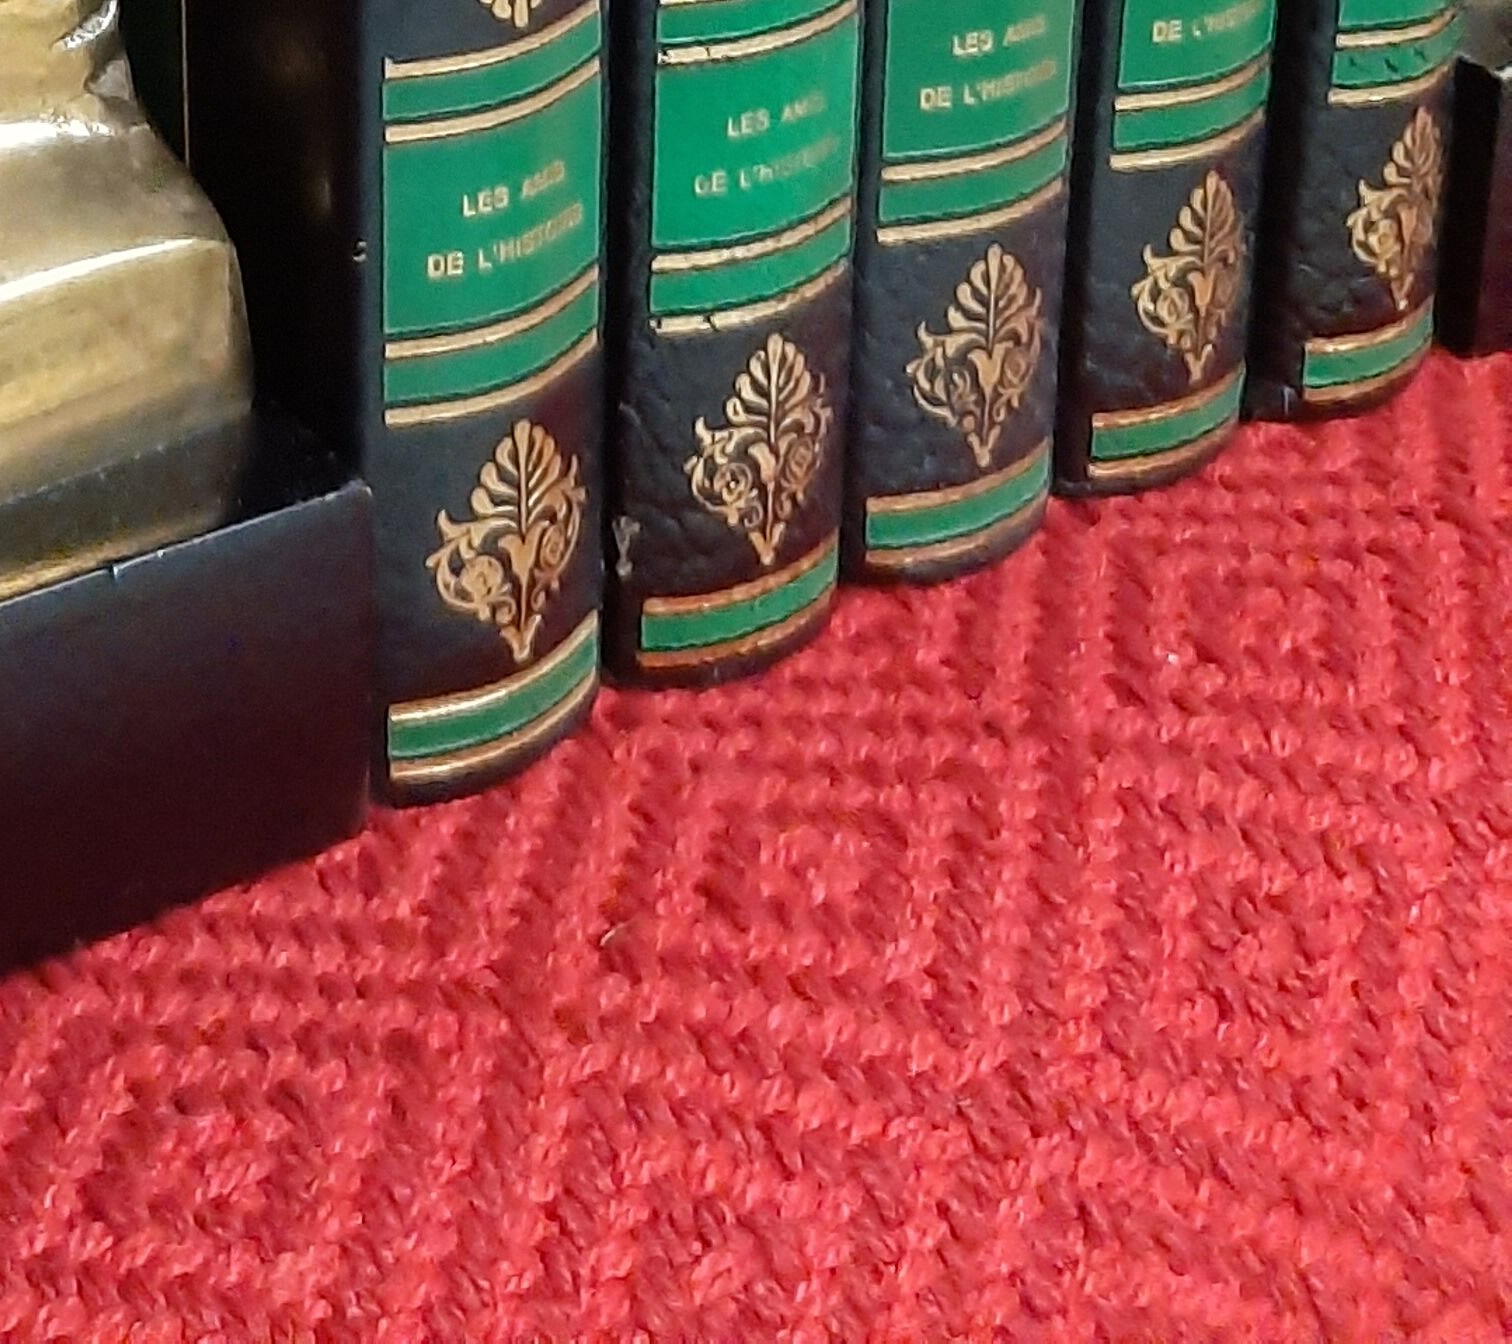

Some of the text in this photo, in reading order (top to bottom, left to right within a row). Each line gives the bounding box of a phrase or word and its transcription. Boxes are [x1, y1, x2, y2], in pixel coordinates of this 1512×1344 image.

[952, 29, 994, 57] LES
[1153, 20, 1183, 44] DE
[920, 85, 953, 111] DE
[727, 108, 770, 137] LES
[694, 170, 728, 197] DE
[462, 186, 510, 218] LES
[427, 251, 465, 279] DE
